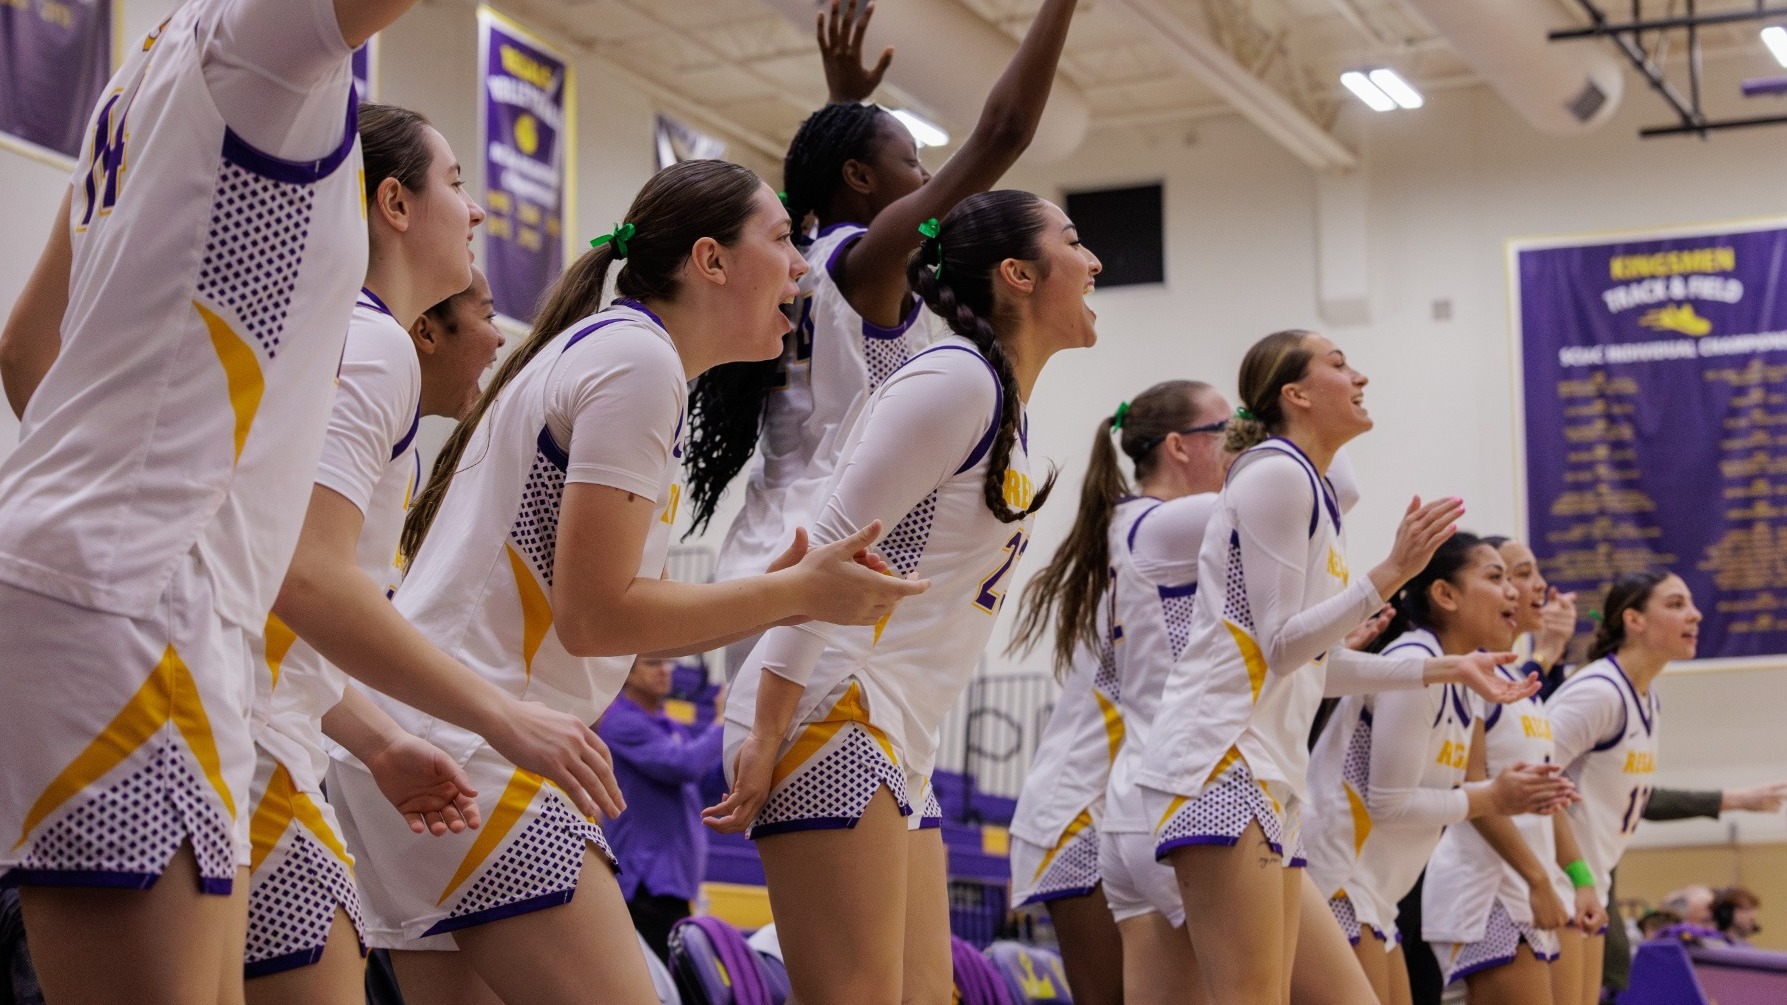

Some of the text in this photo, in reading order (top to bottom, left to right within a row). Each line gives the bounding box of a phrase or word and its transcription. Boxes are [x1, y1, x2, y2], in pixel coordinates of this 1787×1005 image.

[1609, 246, 1735, 281] KINGSMEN
[1602, 274, 1744, 314] TRACK & FIELD
[1604, 340, 1697, 364] INDIVIDUAL
